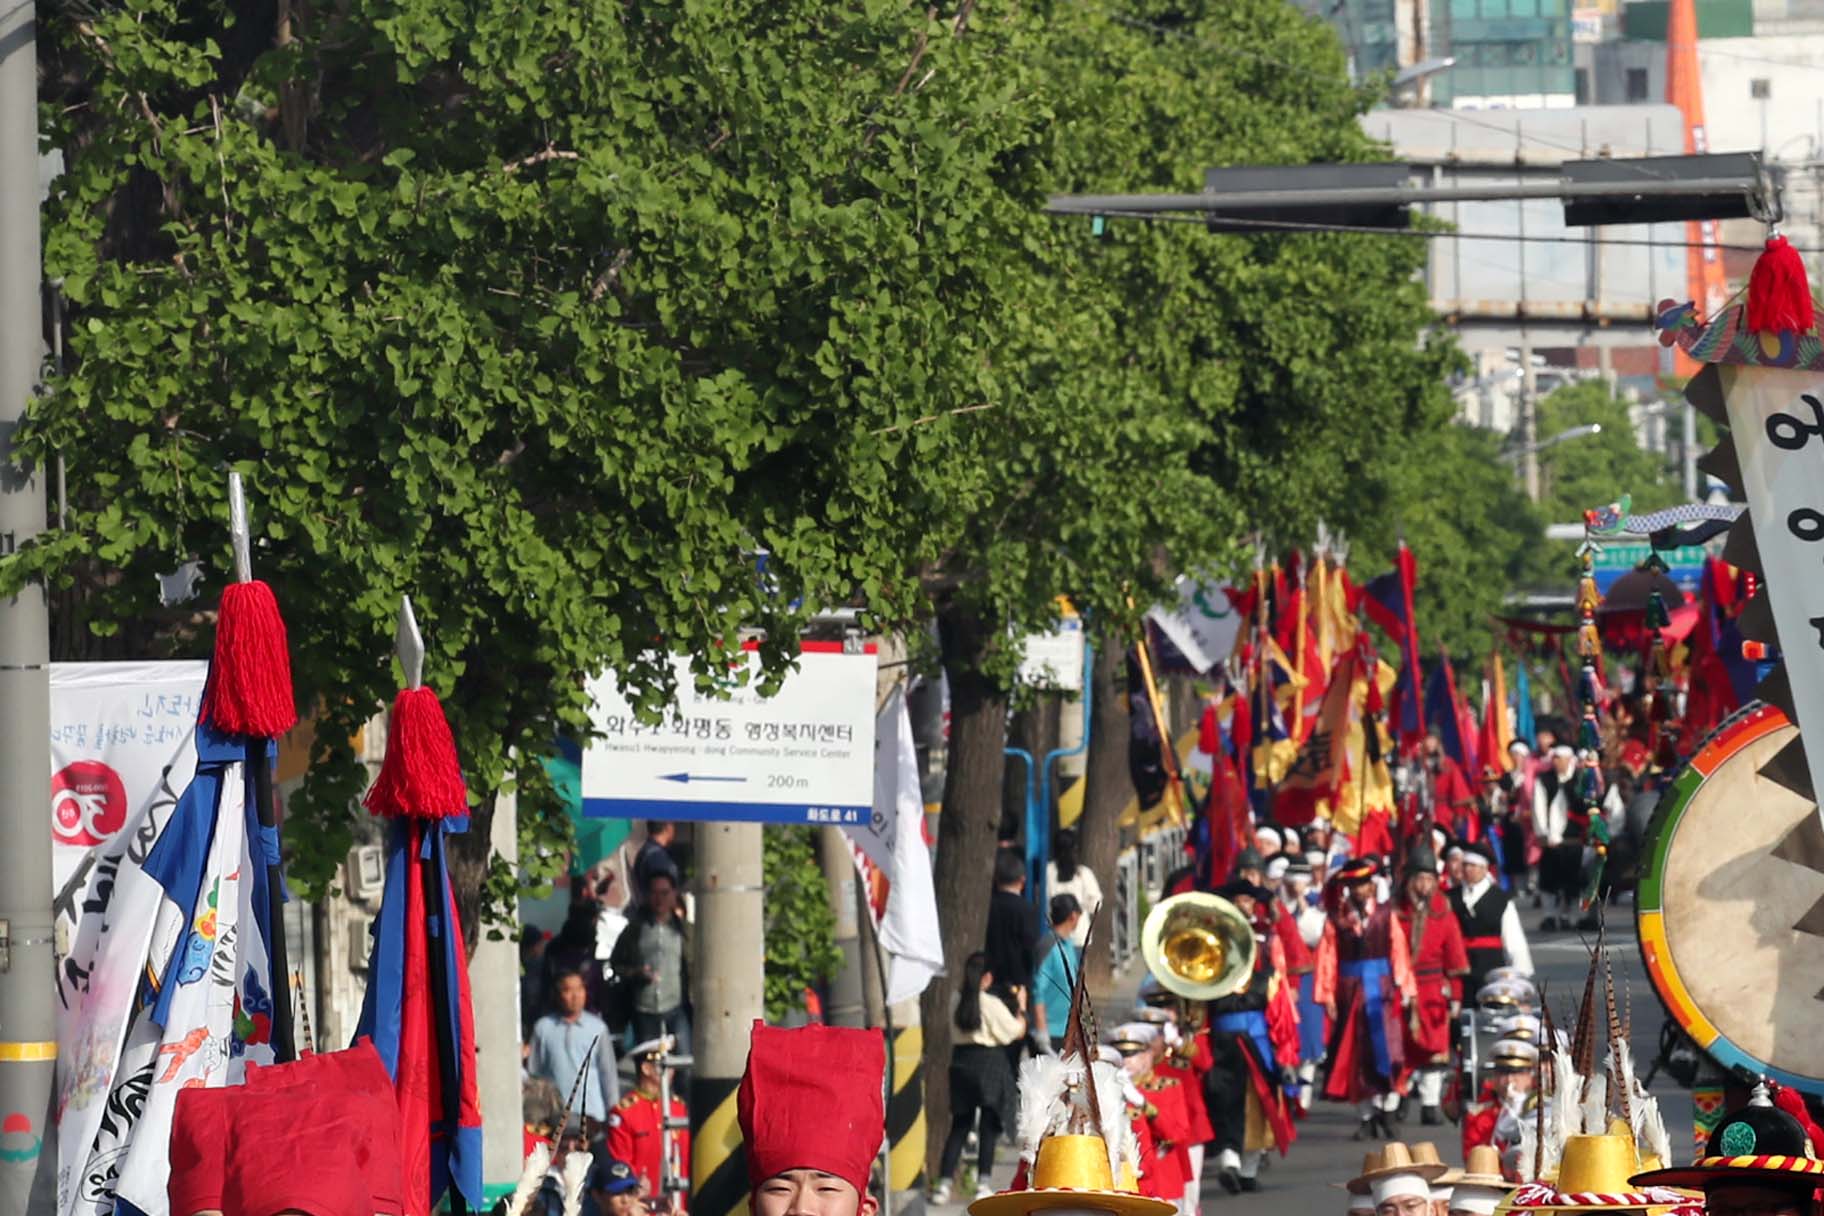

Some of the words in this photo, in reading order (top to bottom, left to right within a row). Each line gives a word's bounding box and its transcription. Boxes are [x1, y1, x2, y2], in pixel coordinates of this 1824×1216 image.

[744, 721, 853, 743] 행정복지센터
[783, 747, 817, 758] Service
[844, 808, 858, 823] 41
